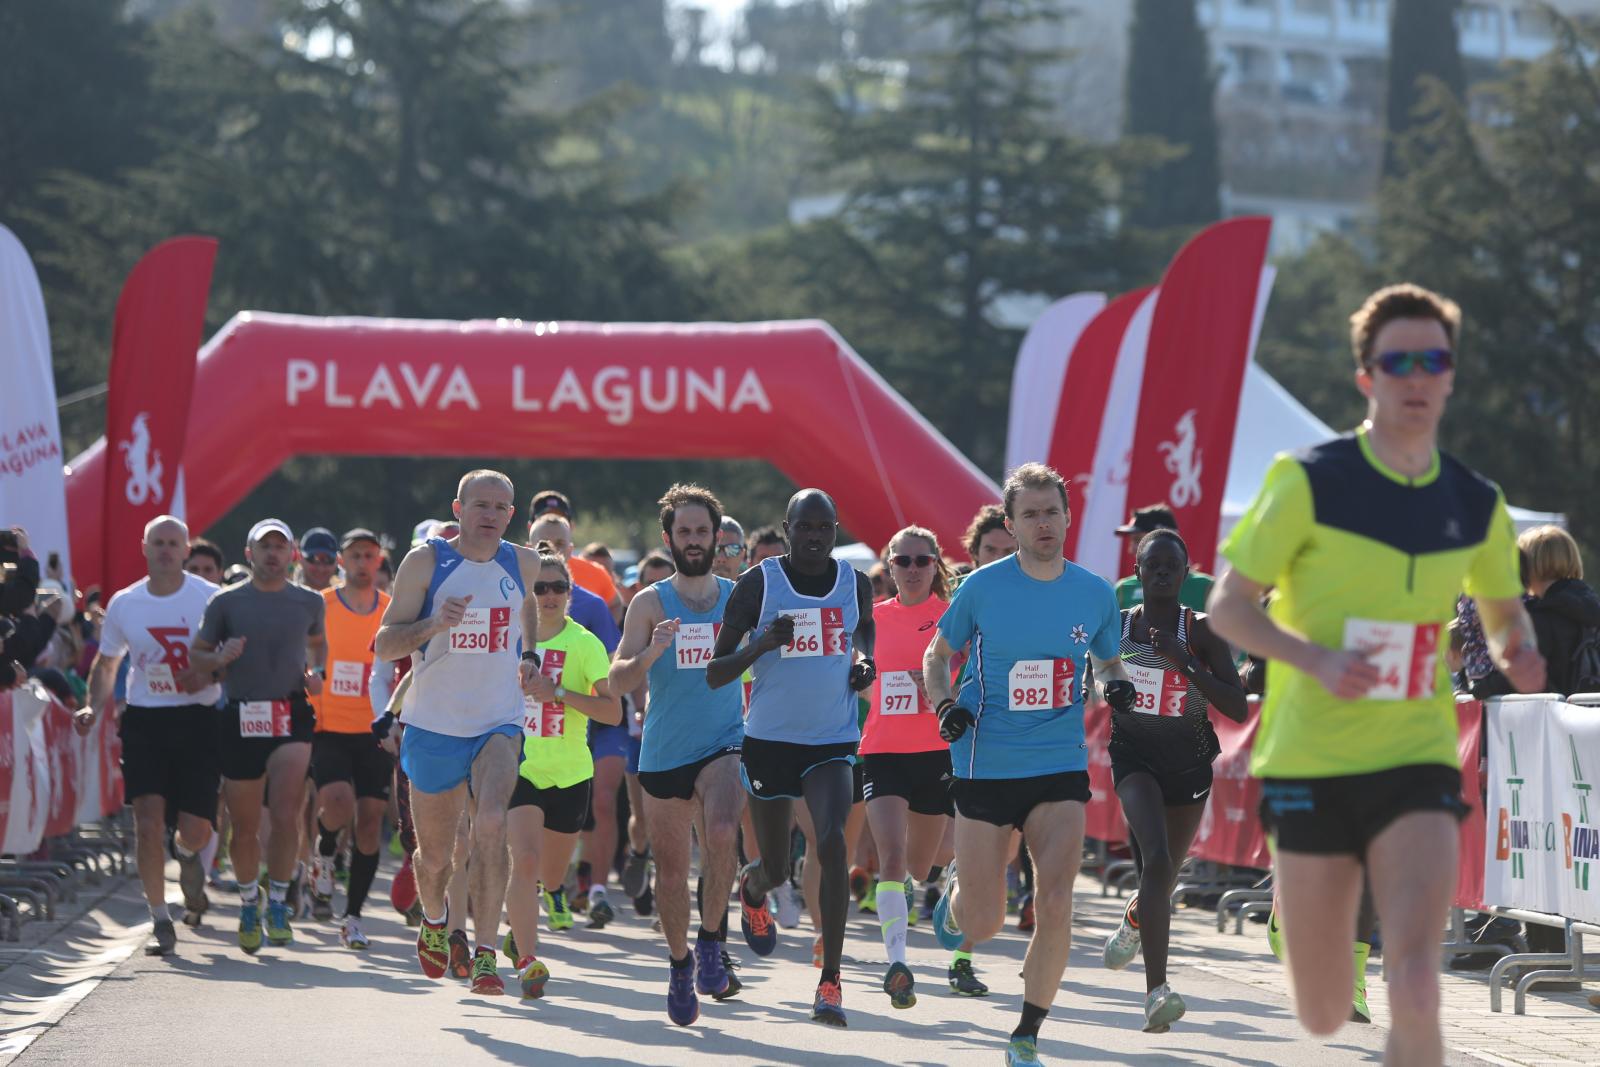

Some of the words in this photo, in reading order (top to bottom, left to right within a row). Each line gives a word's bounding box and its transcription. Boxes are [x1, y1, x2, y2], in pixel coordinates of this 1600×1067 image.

[286, 359, 481, 411] PLAVA
[511, 364, 773, 426] LAGUNA
[1, 421, 49, 452] LAVA
[795, 619, 817, 627] rathon
[450, 632, 488, 649] 1230
[678, 647, 712, 664] 1174
[1015, 672, 1048, 680] Marathon
[1136, 669, 1150, 678] Half
[884, 694, 913, 711] 977
[1012, 687, 1049, 706] 982
[1134, 691, 1156, 710] 83
[242, 720, 273, 734] 1080
